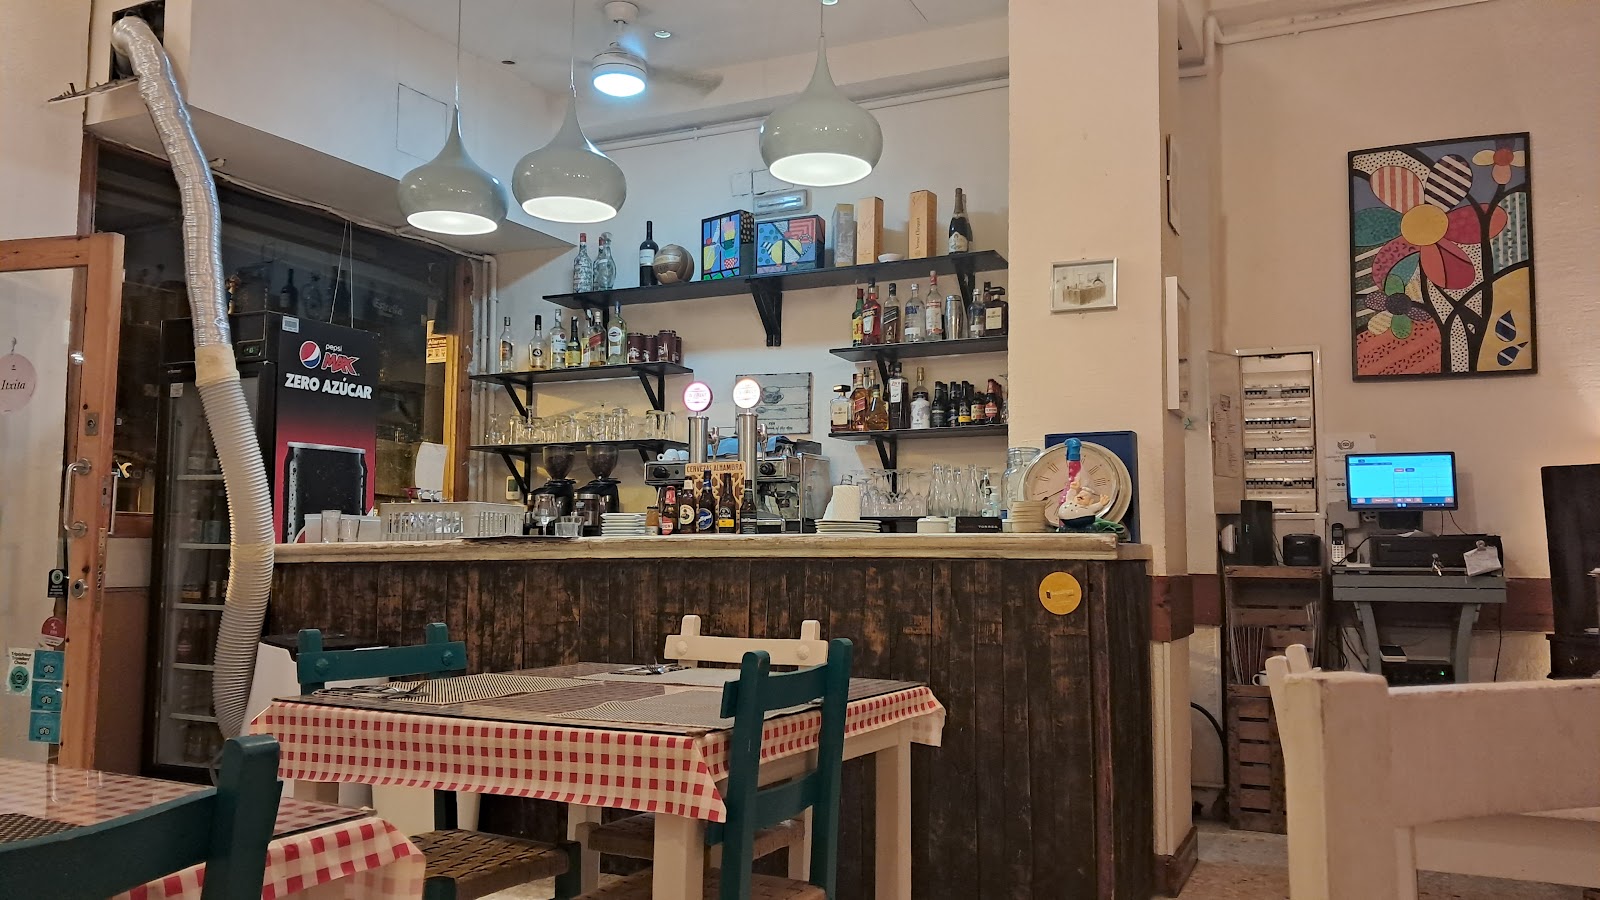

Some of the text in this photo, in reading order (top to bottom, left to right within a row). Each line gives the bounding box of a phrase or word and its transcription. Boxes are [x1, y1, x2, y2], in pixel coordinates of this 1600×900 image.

[325, 343, 343, 352] pepsi
[321, 352, 360, 375] MAX
[1, 379, 26, 390] Itxita
[285, 373, 372, 399] ZERO AZÚCAR
[686, 463, 743, 473] CERVEZAS ALHAMBRA
